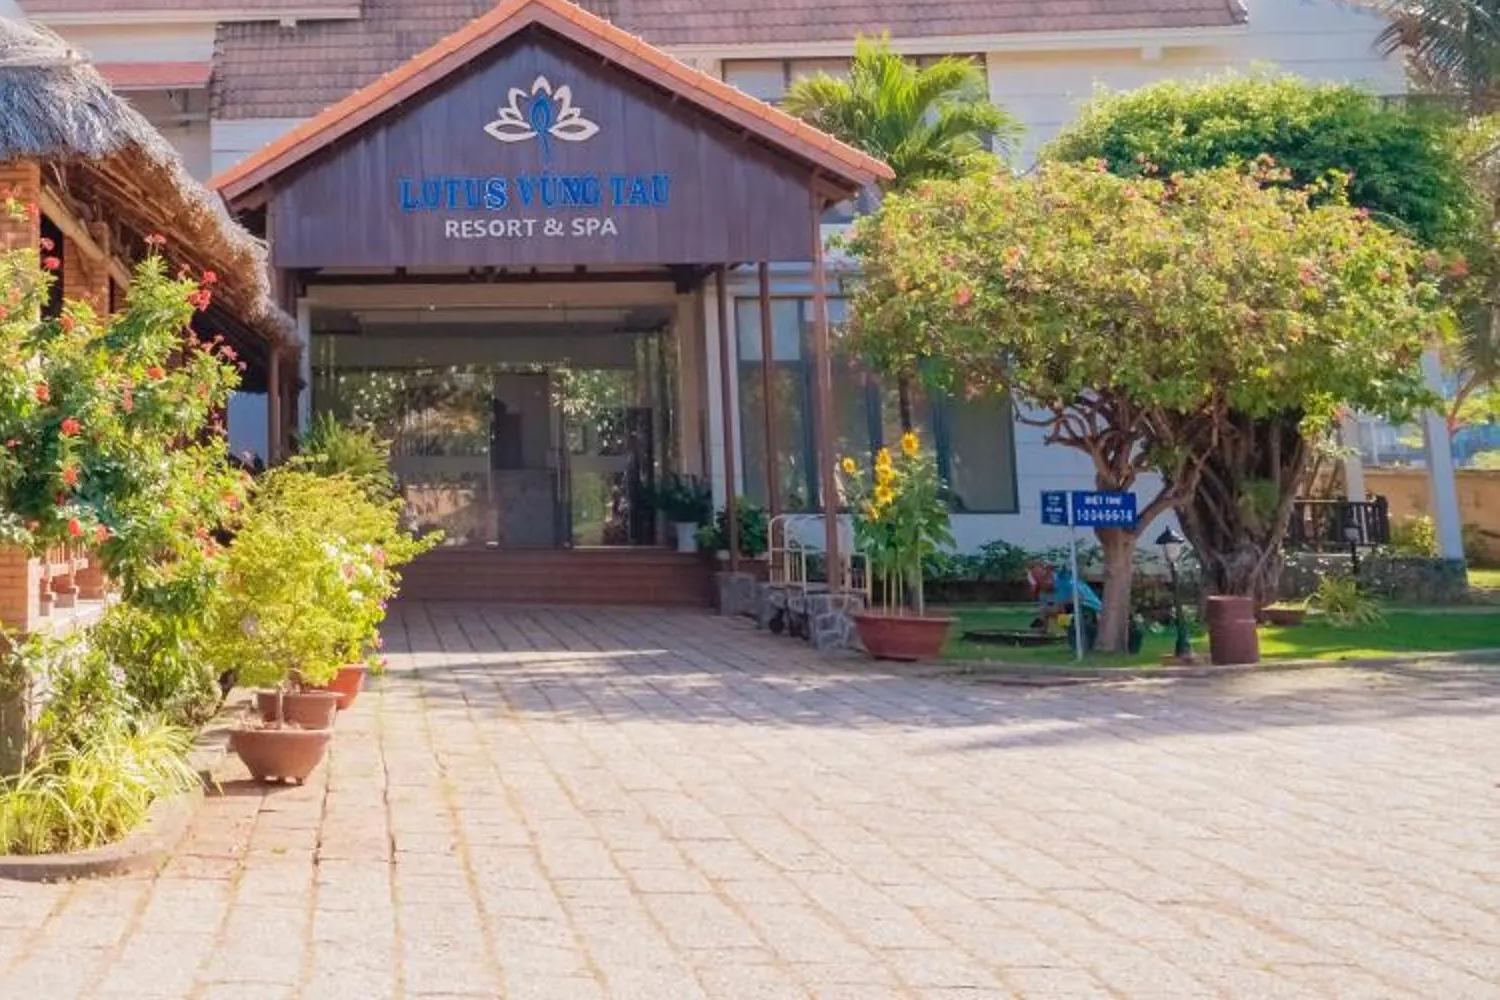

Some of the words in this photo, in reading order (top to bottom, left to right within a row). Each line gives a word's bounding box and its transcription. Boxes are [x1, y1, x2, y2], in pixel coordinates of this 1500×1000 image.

[400, 176, 508, 209] LOTUS
[445, 219, 537, 238] RESORT
[543, 218, 565, 237] &
[571, 217, 618, 236] SPA
